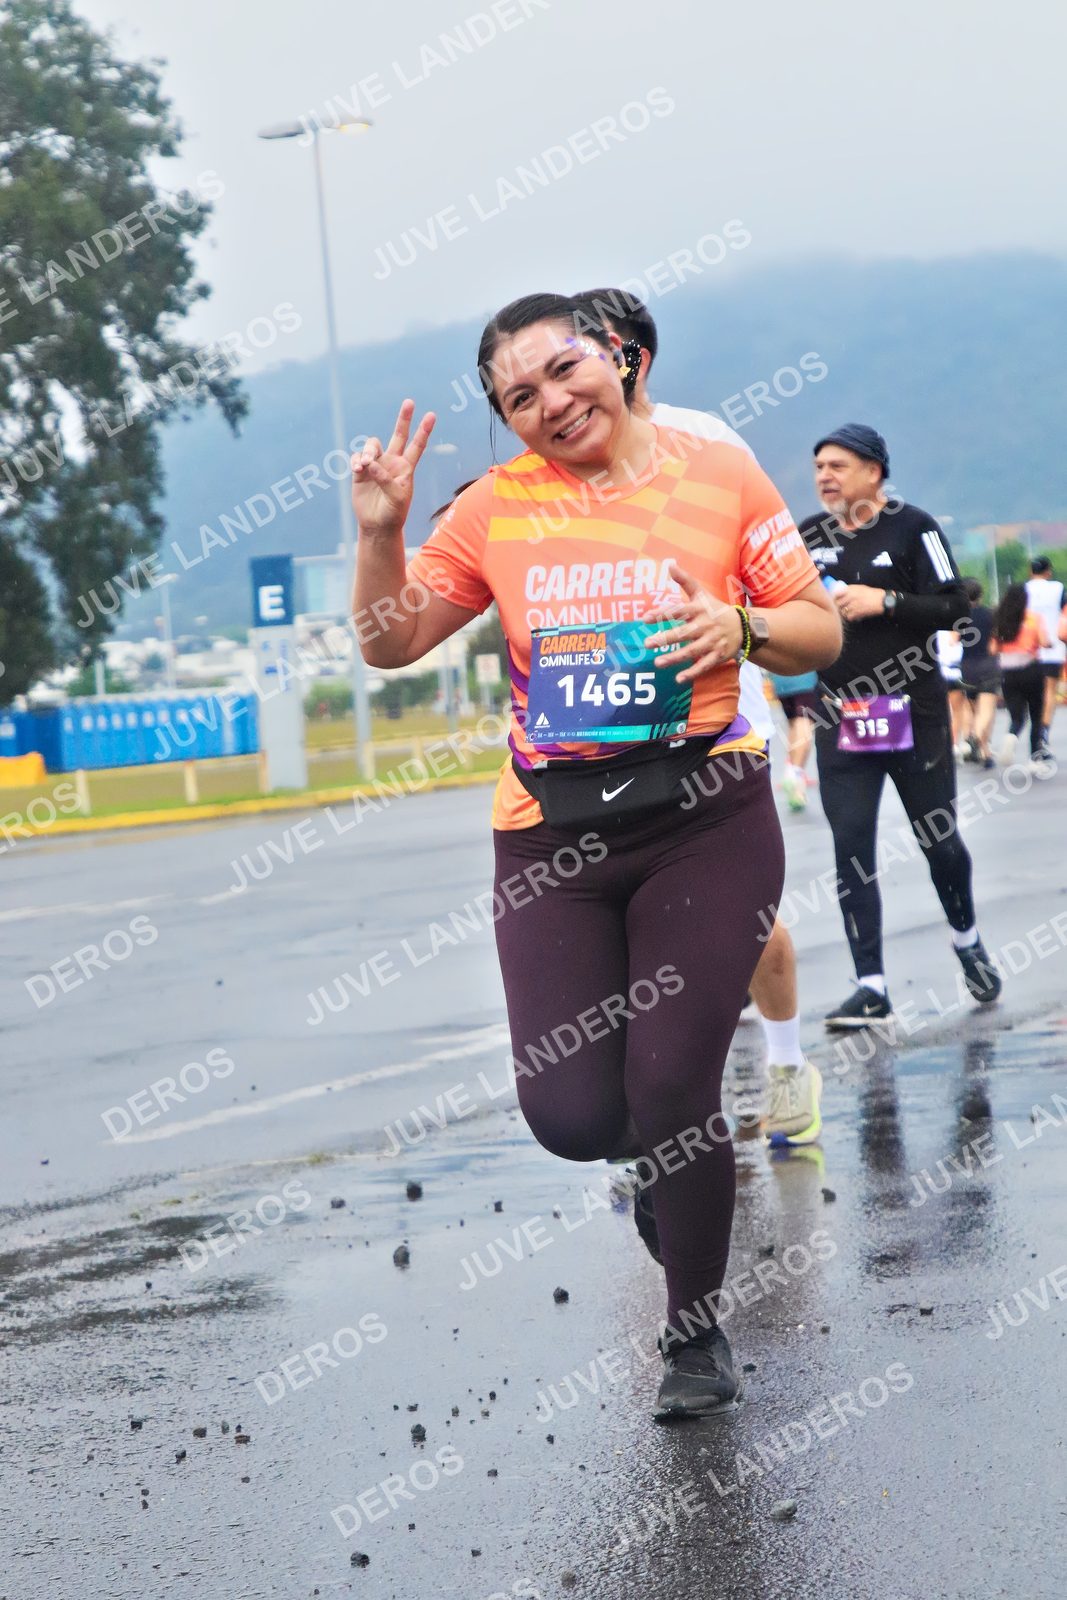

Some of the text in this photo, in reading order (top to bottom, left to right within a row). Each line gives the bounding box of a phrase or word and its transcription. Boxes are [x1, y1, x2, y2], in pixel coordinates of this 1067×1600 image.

[525, 558, 681, 603] CARRERA
[259, 585, 285, 620] E
[540, 632, 606, 655] CARRERA
[557, 672, 656, 708] 1465
[855, 718, 889, 738] 315
